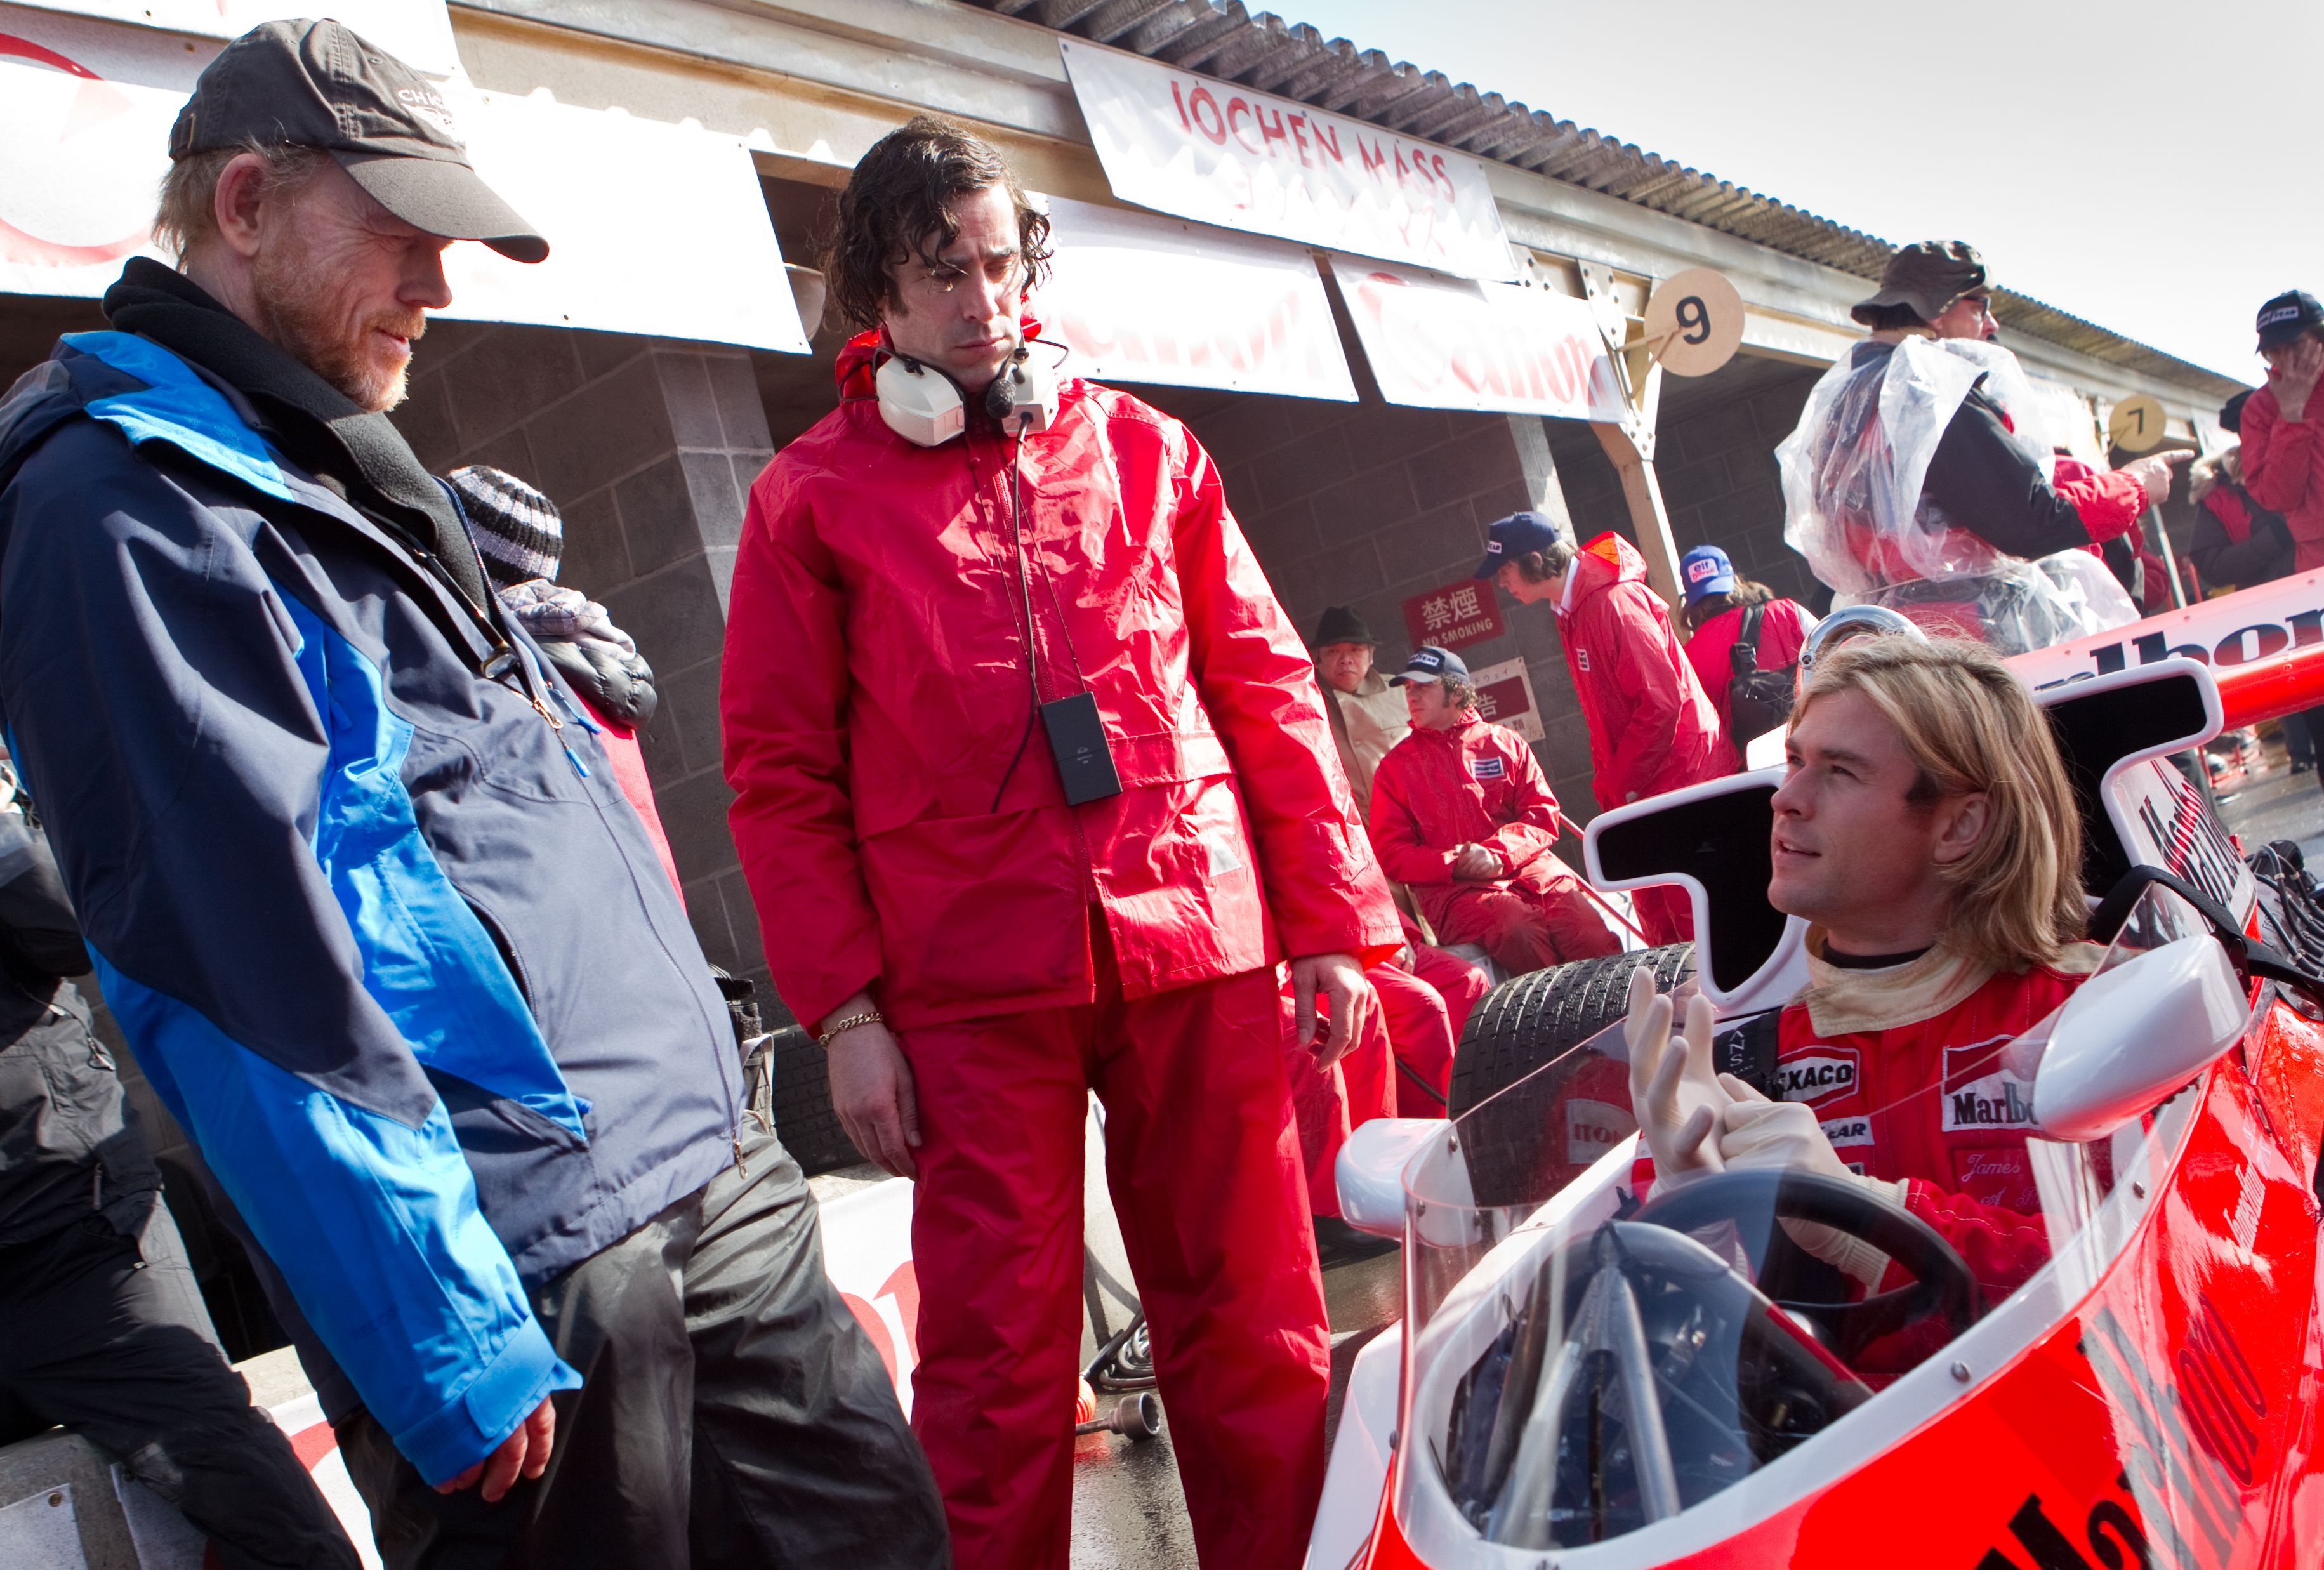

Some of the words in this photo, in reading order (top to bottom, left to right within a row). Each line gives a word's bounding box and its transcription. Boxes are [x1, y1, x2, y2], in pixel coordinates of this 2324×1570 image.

[1170, 80, 1345, 172] JOCHEN
[1357, 131, 1456, 204] MASS
[1676, 296, 1711, 345] 9
[2127, 407, 2143, 435] 7
[1694, 562, 1708, 572] elf
[1422, 586, 1481, 631] 禁煙
[1422, 636, 1439, 647] NO
[1441, 617, 1493, 645] SMOKING
[1961, 1153, 2021, 1182] James
